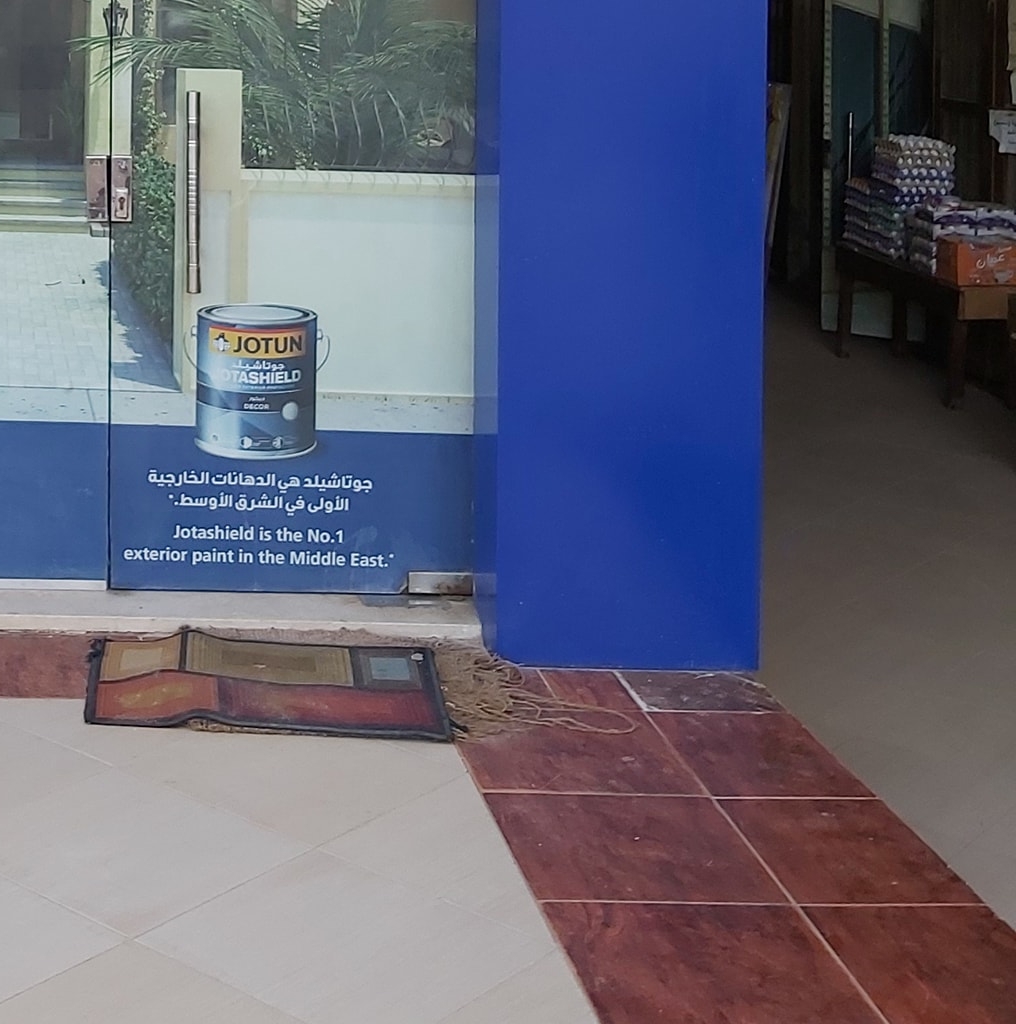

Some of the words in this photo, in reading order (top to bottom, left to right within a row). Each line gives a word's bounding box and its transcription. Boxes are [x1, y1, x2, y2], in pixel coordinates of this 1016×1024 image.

[233, 335, 303, 355] JOTUN
[215, 370, 302, 385] OTASHIELD
[148, 469, 210, 488] الخارجية
[211, 471, 276, 488] الدهانات
[278, 475, 300, 493] هي
[303, 473, 373, 492] جوتاشيلد
[235, 495, 284, 512] الشرق
[285, 499, 305, 516] في
[173, 525, 254, 541] Jotashield
[259, 527, 272, 541] is
[276, 527, 302, 543] the
[307, 529, 344, 544] No.1
[123, 547, 187, 562] exterior
[192, 548, 235, 567] paint
[238, 549, 254, 564] in
[258, 549, 285, 565] the
[289, 551, 346, 567] Middle
